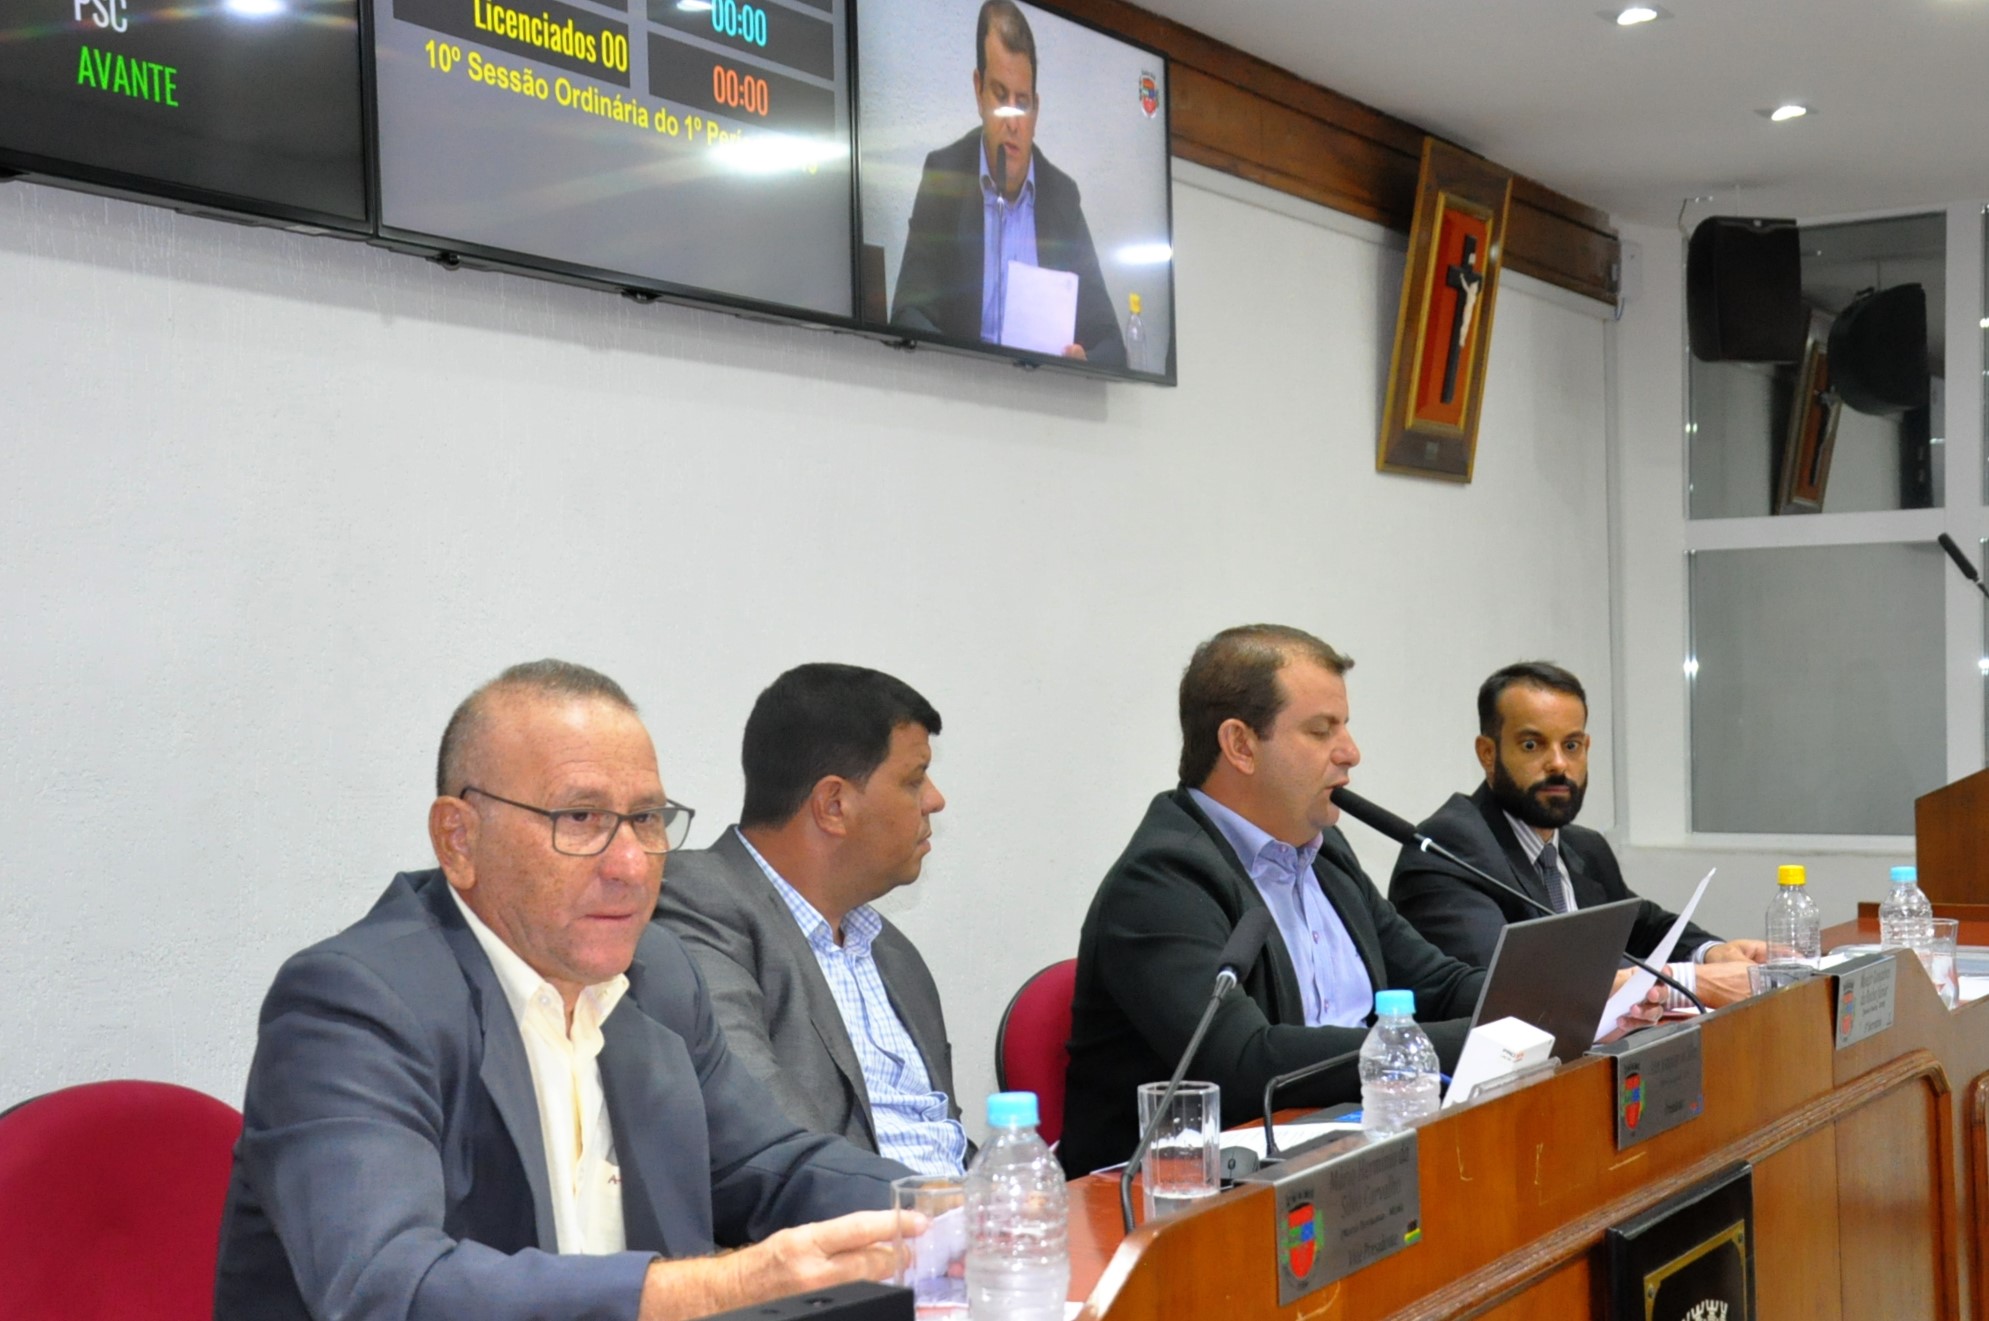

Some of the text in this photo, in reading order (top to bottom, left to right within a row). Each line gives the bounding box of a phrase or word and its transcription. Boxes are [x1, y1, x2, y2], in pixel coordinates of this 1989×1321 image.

[473, 0, 628, 73] Licenciados 00
[711, 0, 767, 47] 00:00
[77, 45, 179, 107] AVANTE
[467, 51, 549, 100] Sessão
[554, 77, 649, 129] Ordinária
[654, 107, 679, 137] do
[713, 65, 768, 116] 00:00
